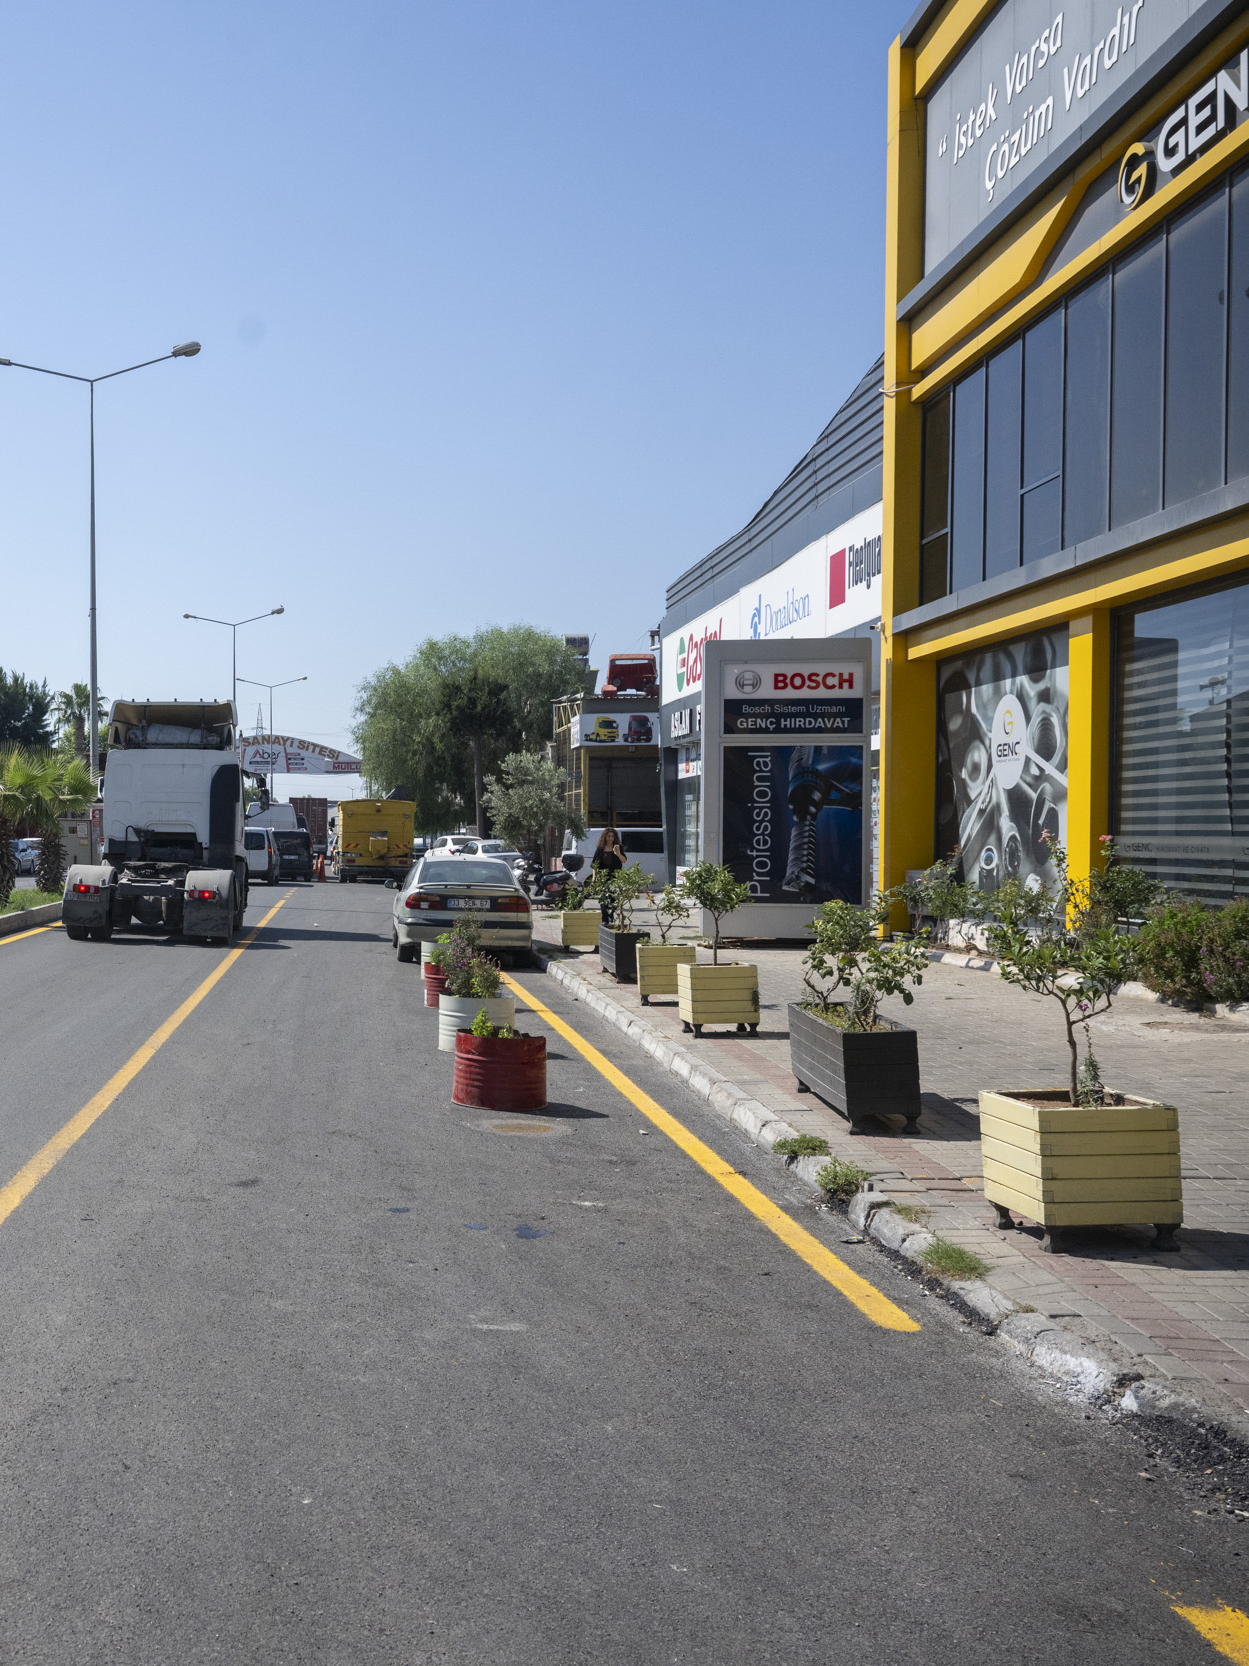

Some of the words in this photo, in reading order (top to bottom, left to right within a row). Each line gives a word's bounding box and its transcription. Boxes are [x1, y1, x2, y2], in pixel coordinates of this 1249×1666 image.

[1005, 11, 1065, 104] Varsa
[985, 95, 1053, 203] Çözüm
[1063, 0, 1144, 112] Vardır
[1157, 48, 1248, 172] GEN
[848, 533, 883, 590] Fleetgua
[764, 587, 811, 637] Donaldson
[742, 704, 771, 713] Bosch
[774, 704, 806, 713] Sistem
[809, 704, 846, 713] Uzmanı
[773, 672, 854, 690] BOSCH
[737, 717, 776, 731] GENÇ
[781, 717, 850, 729] HIRDAVAT
[747, 752, 771, 897] Professional
